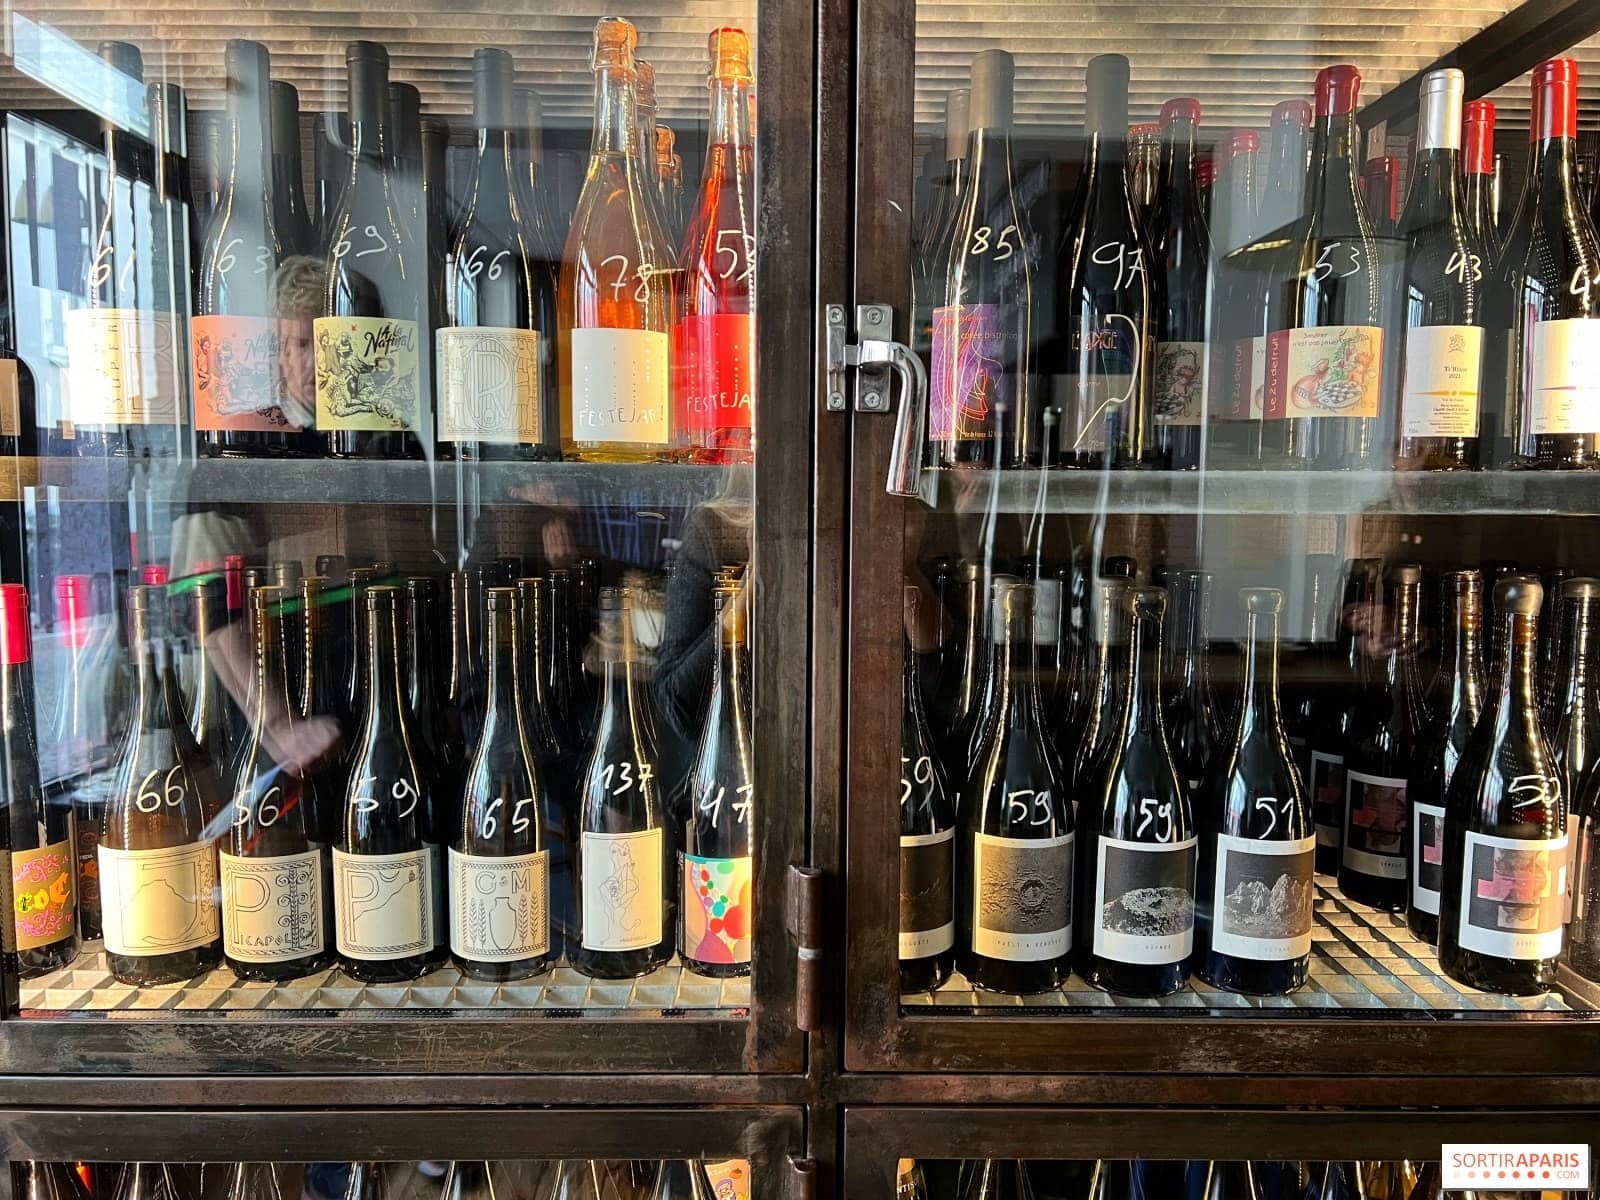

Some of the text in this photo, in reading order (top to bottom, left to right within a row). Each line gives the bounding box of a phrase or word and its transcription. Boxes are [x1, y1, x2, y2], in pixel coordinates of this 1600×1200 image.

[217, 238, 271, 274] 63
[332, 225, 388, 258] 69
[970, 225, 1017, 261] 85
[1316, 242, 1361, 282] 53
[467, 246, 511, 281] 66
[600, 255, 684, 303] 78
[1092, 242, 1146, 291] 97
[1444, 251, 1483, 284] 43
[1568, 264, 1600, 306] 4
[687, 392, 752, 413] FESTEJA
[135, 765, 186, 813] 66
[352, 776, 418, 818] 59
[591, 762, 654, 796] 137
[233, 786, 281, 827] 56
[481, 798, 534, 840] 65
[700, 780, 753, 829] 47
[1007, 789, 1052, 826] 59
[1136, 798, 1173, 844] 59
[1255, 797, 1295, 840] 51
